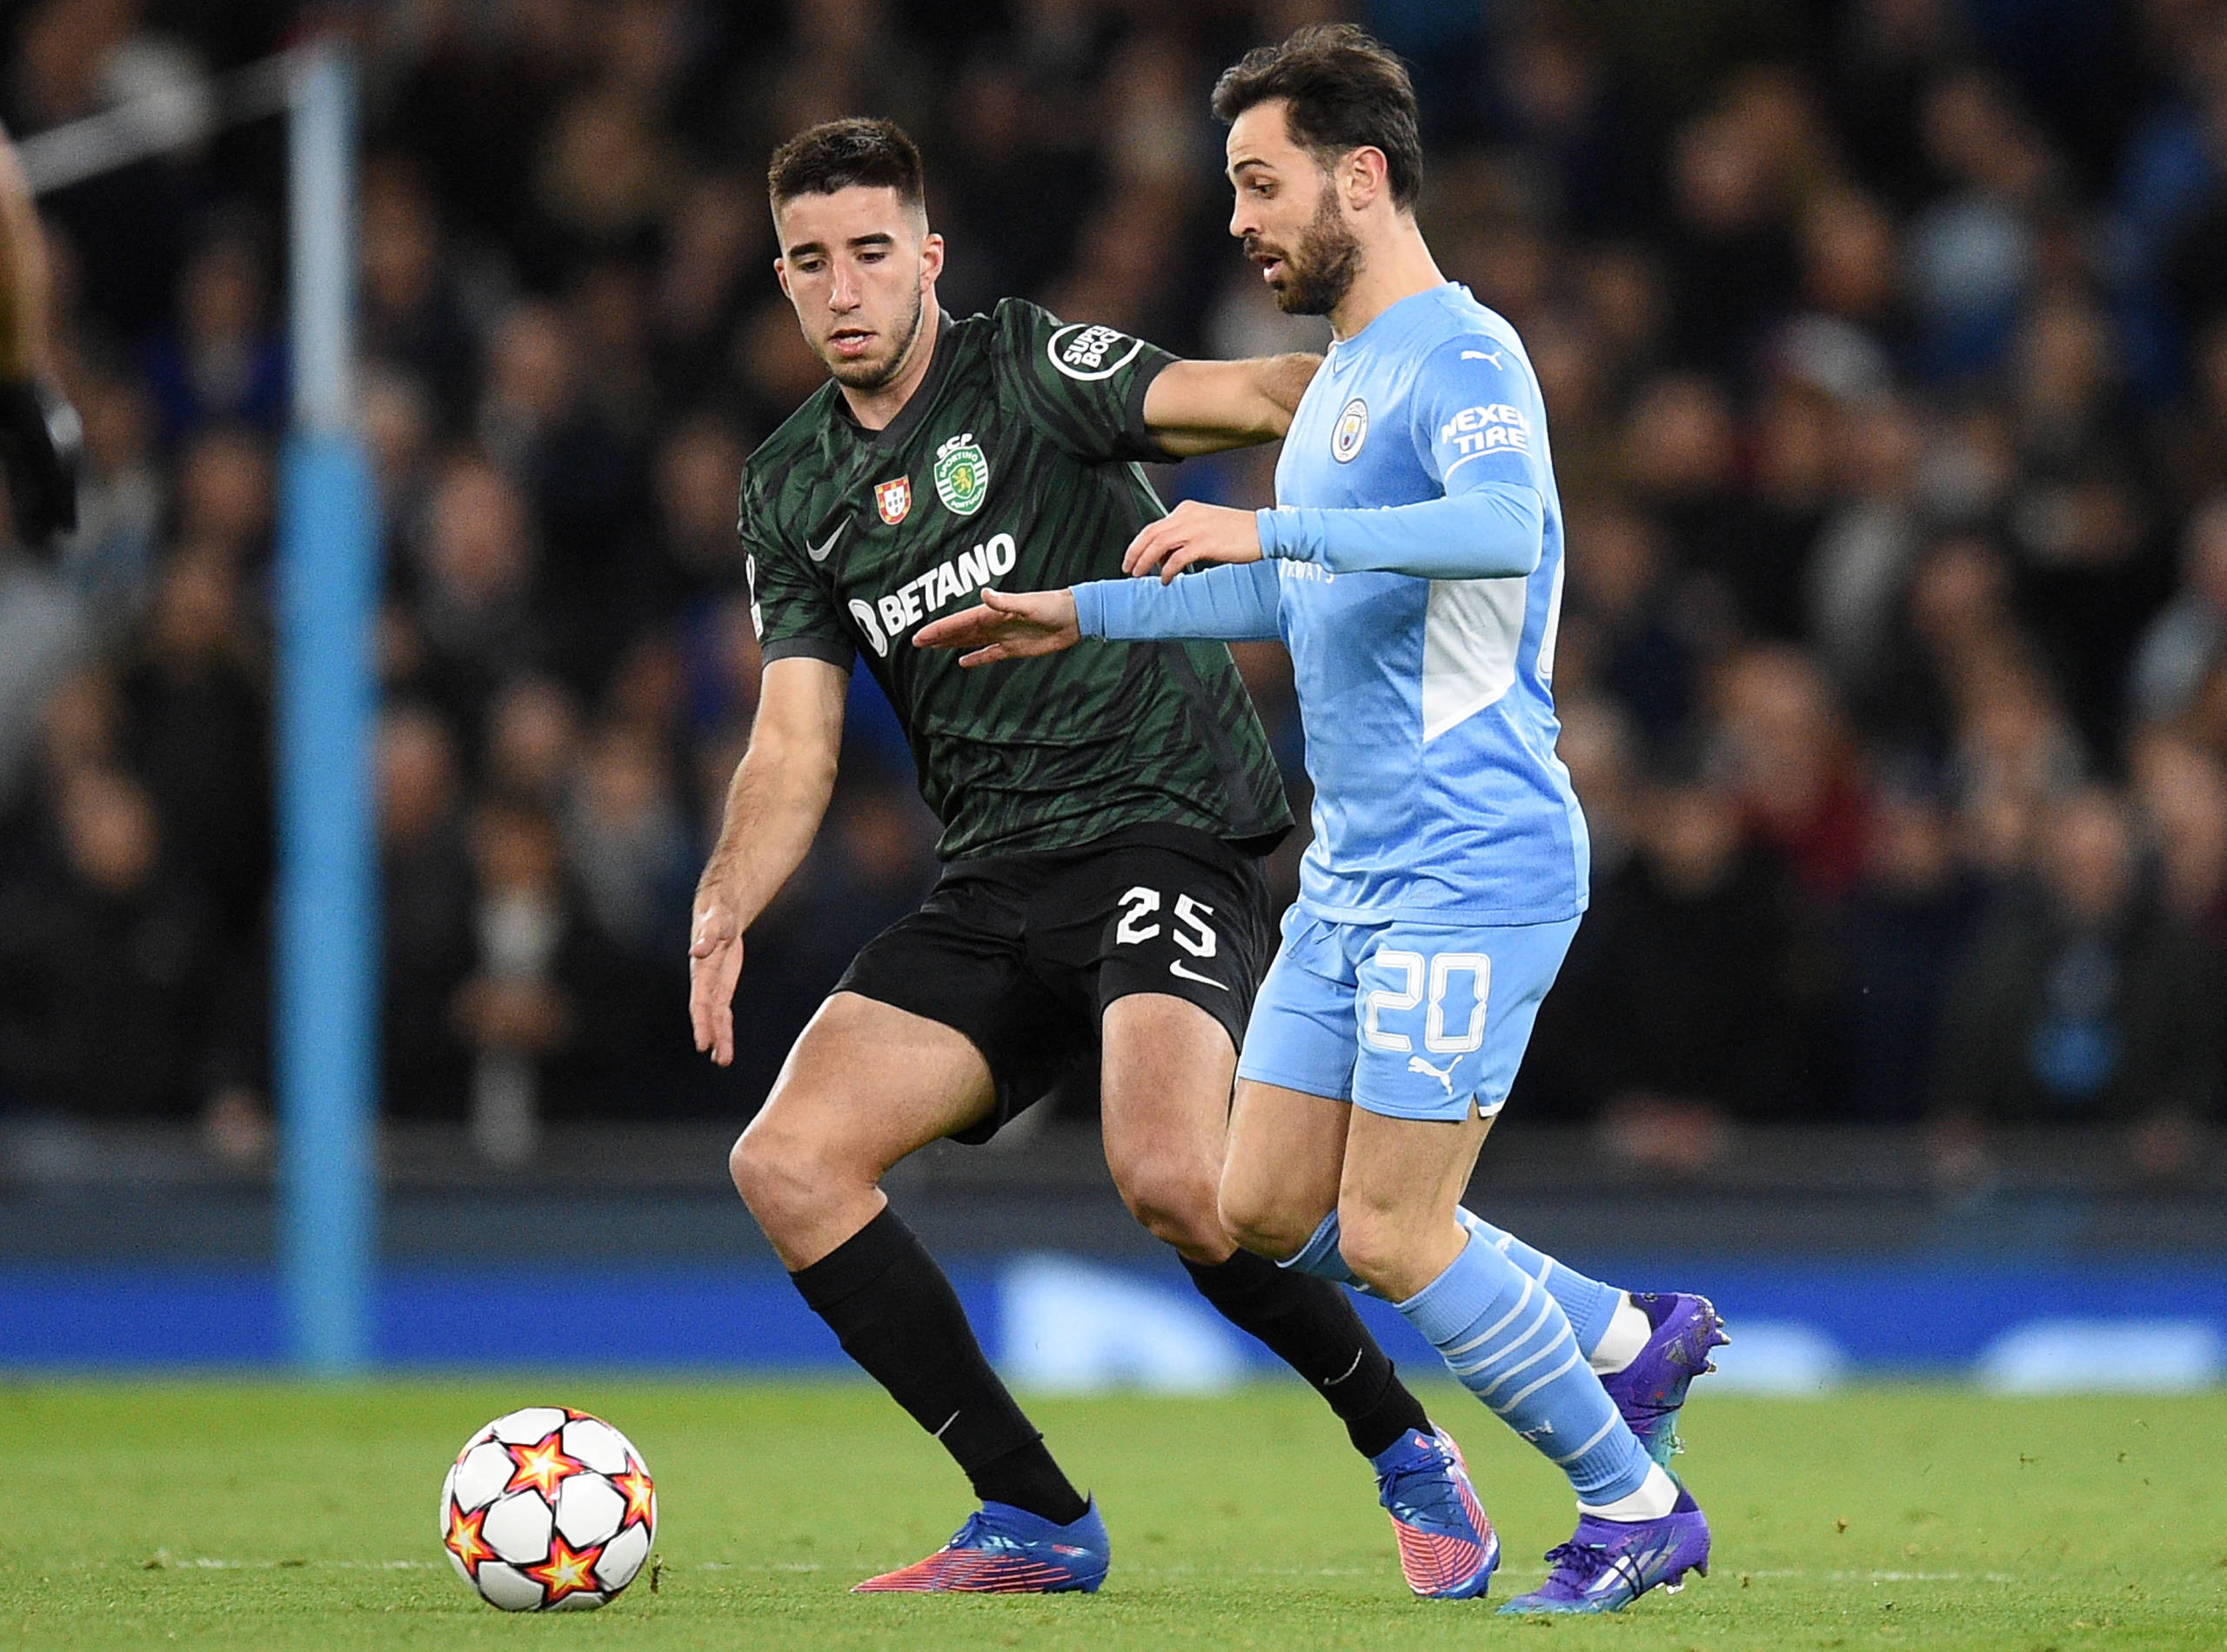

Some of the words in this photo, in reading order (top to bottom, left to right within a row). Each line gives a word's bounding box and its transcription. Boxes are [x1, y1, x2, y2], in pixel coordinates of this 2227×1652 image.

[1063, 325, 1110, 365] SUPE
[1081, 330, 1121, 368] BOC
[936, 433, 973, 458] SCP
[1454, 425, 1528, 454] TIRE
[878, 532, 1017, 637] BETANO
[1116, 886, 1216, 957] 25
[1364, 950, 1491, 1053] 20
